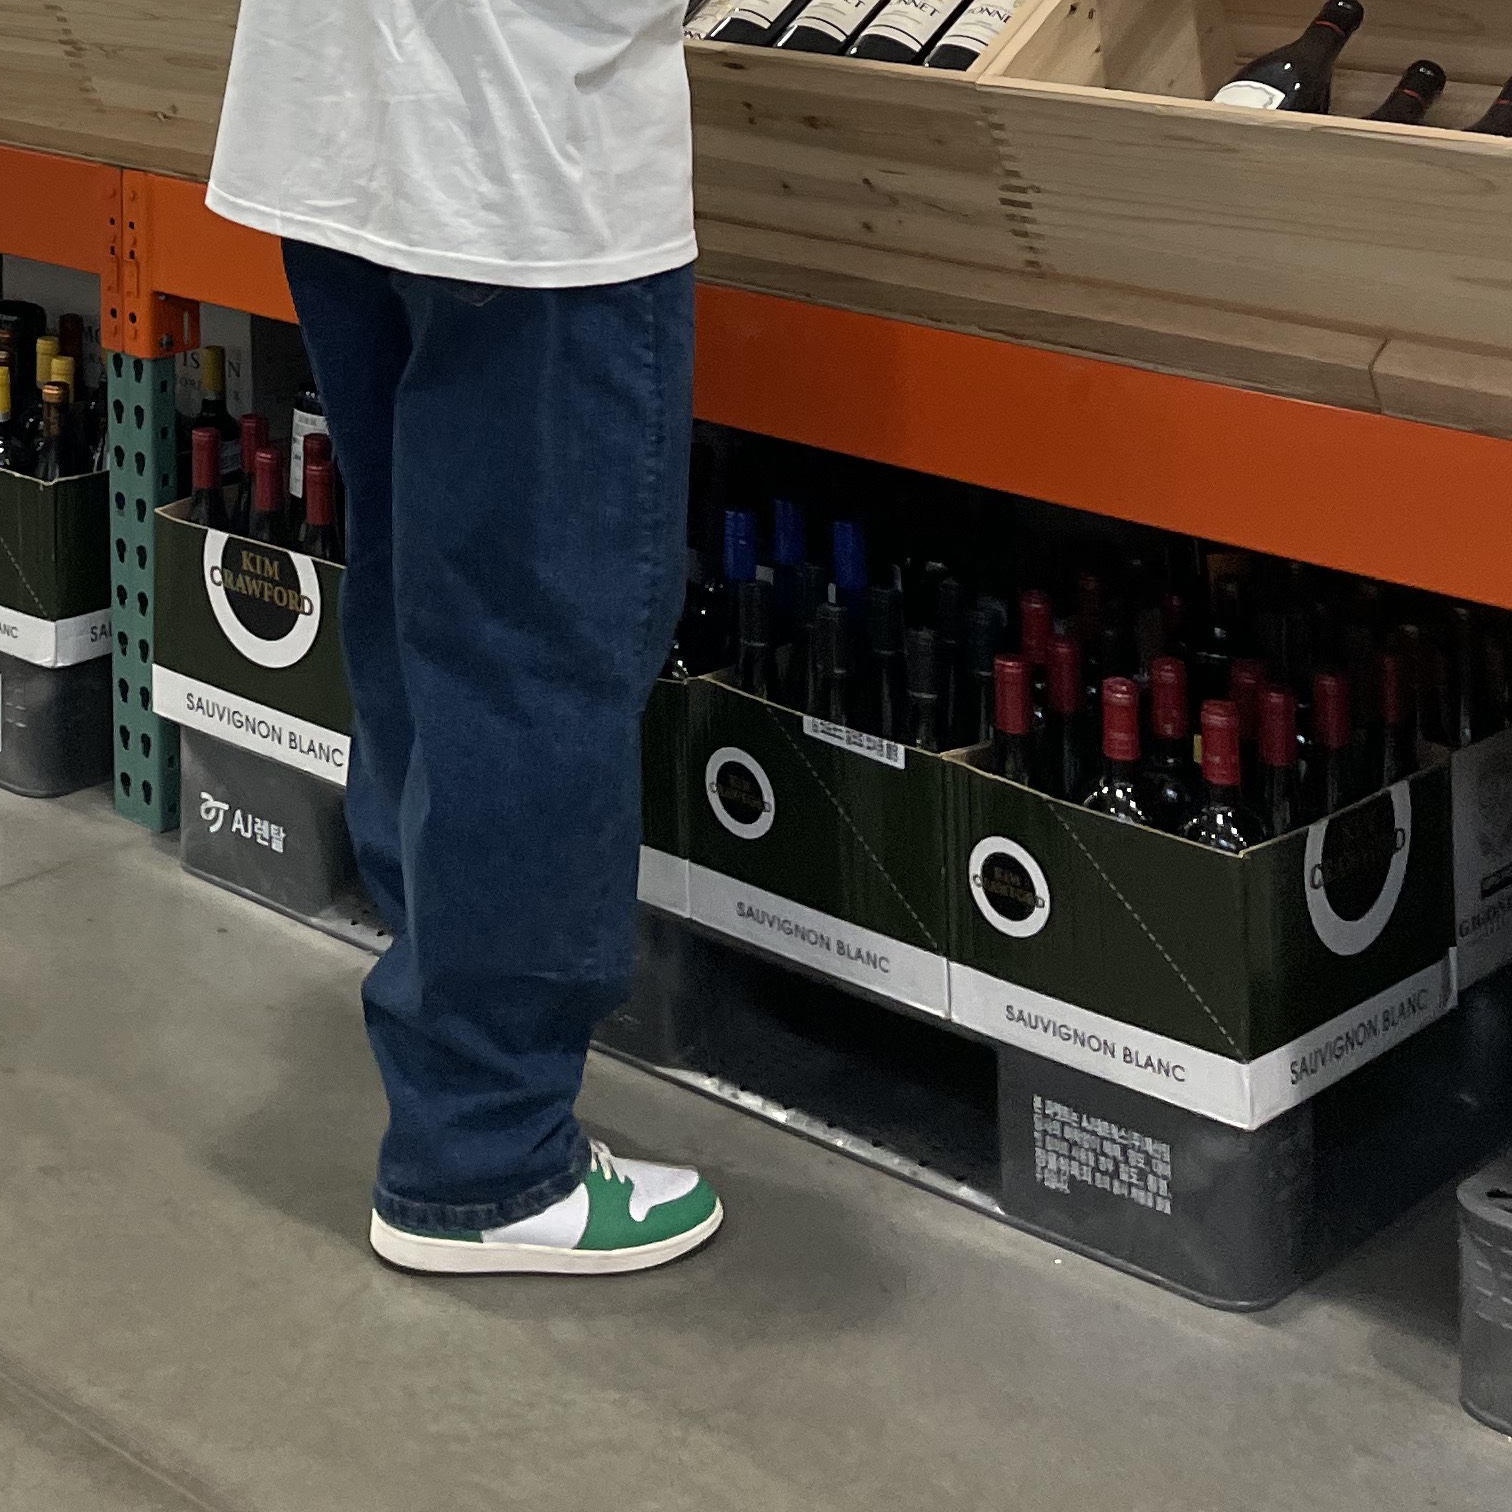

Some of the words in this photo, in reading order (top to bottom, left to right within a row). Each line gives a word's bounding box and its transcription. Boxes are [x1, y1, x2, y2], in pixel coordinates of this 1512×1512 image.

[209, 565, 314, 617] CRAWFORD
[240, 550, 280, 581] KIM
[186, 692, 282, 745] SAUVIGNON
[288, 730, 344, 768] BLANC
[231, 808, 286, 854] AJ렌탈
[736, 901, 831, 953] SAUVIGNON
[836, 939, 891, 974] BLANC
[1005, 1004, 1117, 1059] SAUVIGNON
[1123, 1045, 1187, 1083] BLANC
[1290, 1017, 1379, 1086] SAUVIGNON
[1382, 988, 1429, 1034] BLANC
